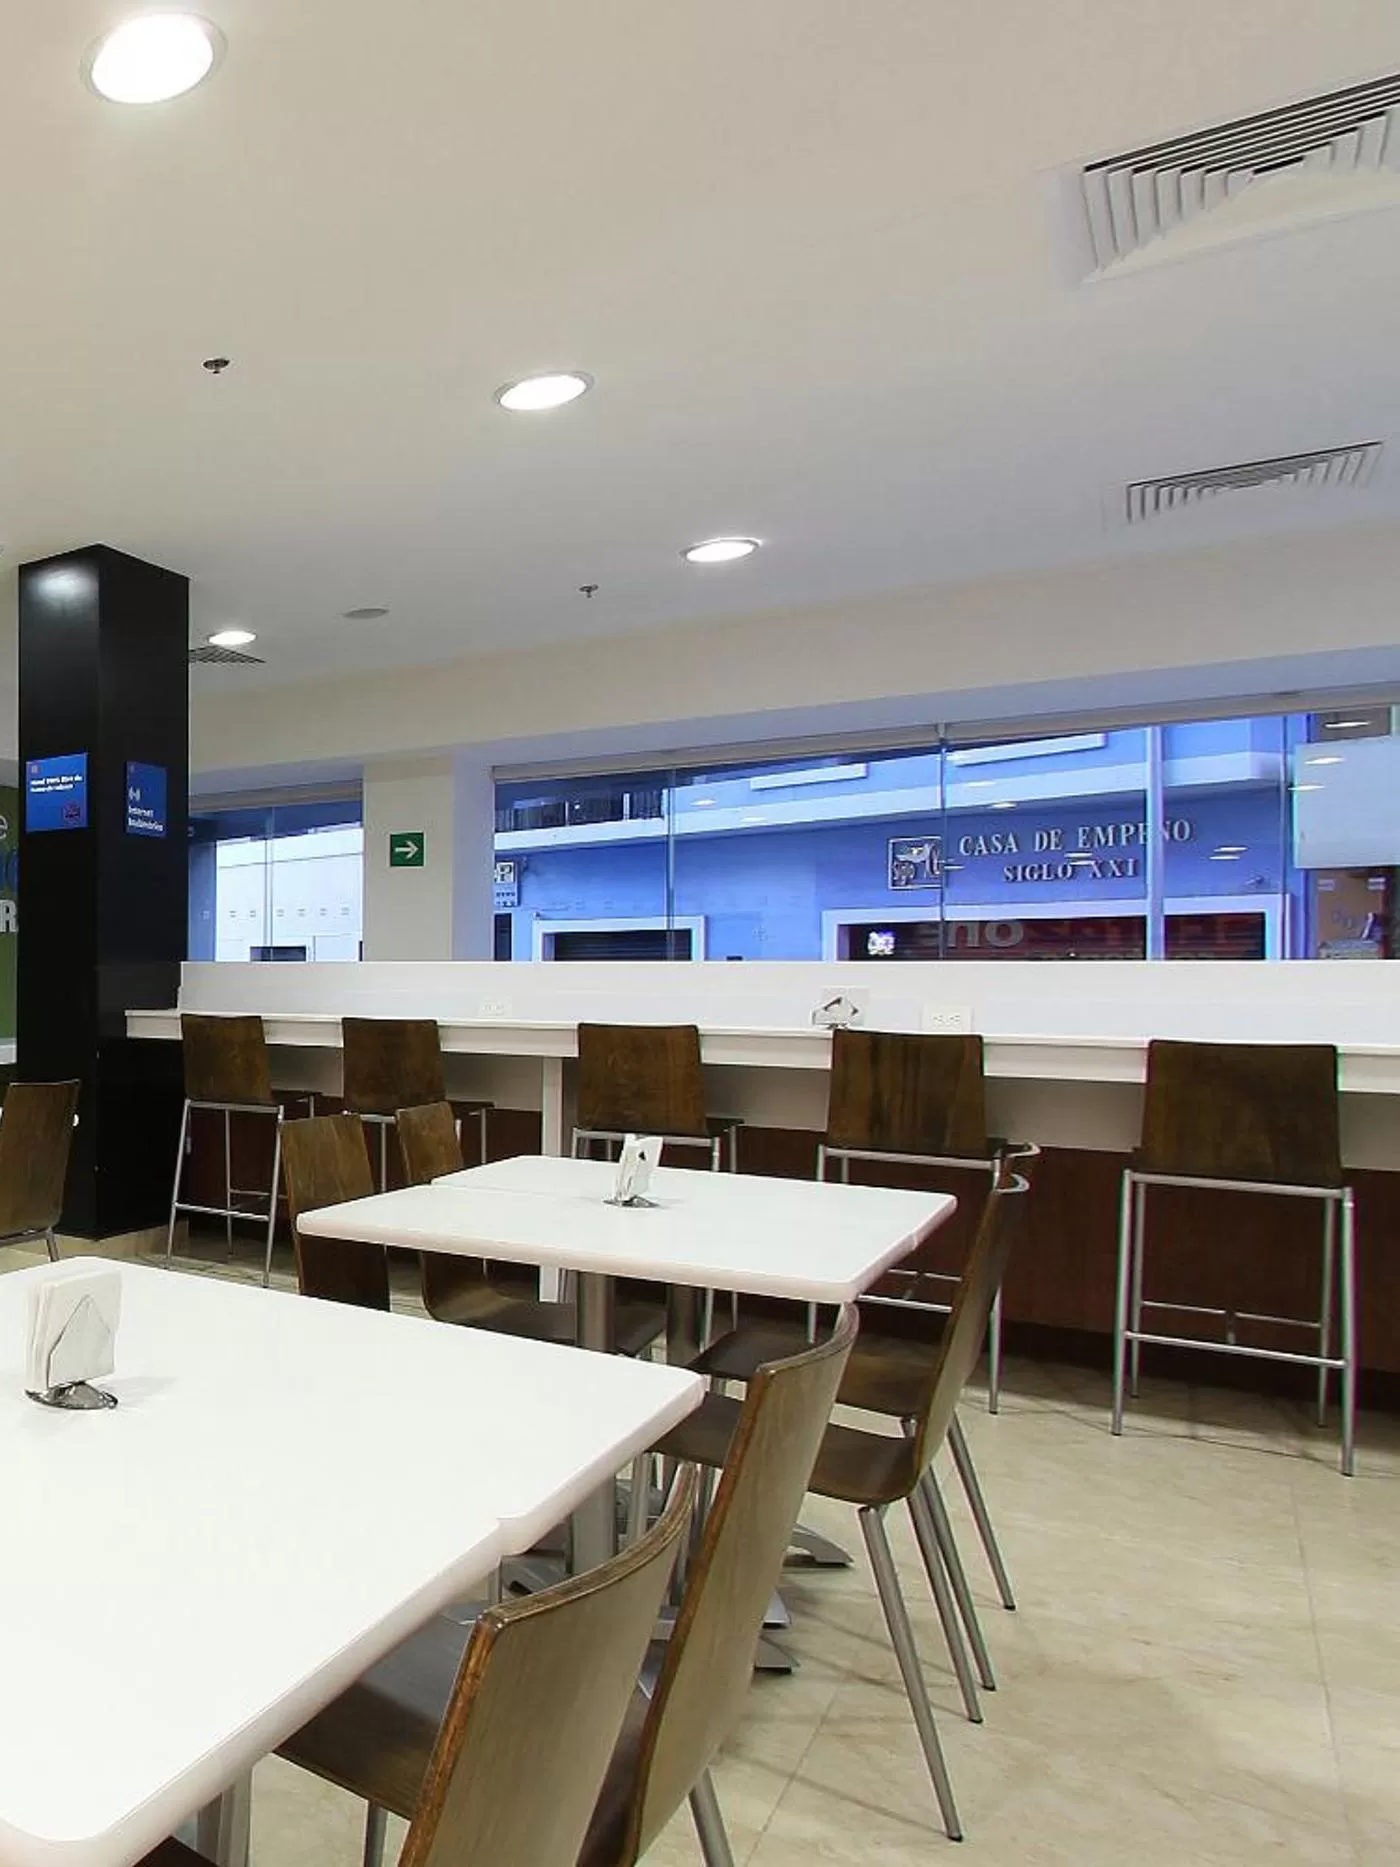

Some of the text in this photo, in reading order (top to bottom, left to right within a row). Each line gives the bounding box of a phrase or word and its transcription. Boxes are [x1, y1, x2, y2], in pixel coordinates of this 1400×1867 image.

[960, 834, 1018, 857] CASA
[1034, 827, 1062, 853] DE
[1003, 857, 1136, 883] SIGLO XXI
